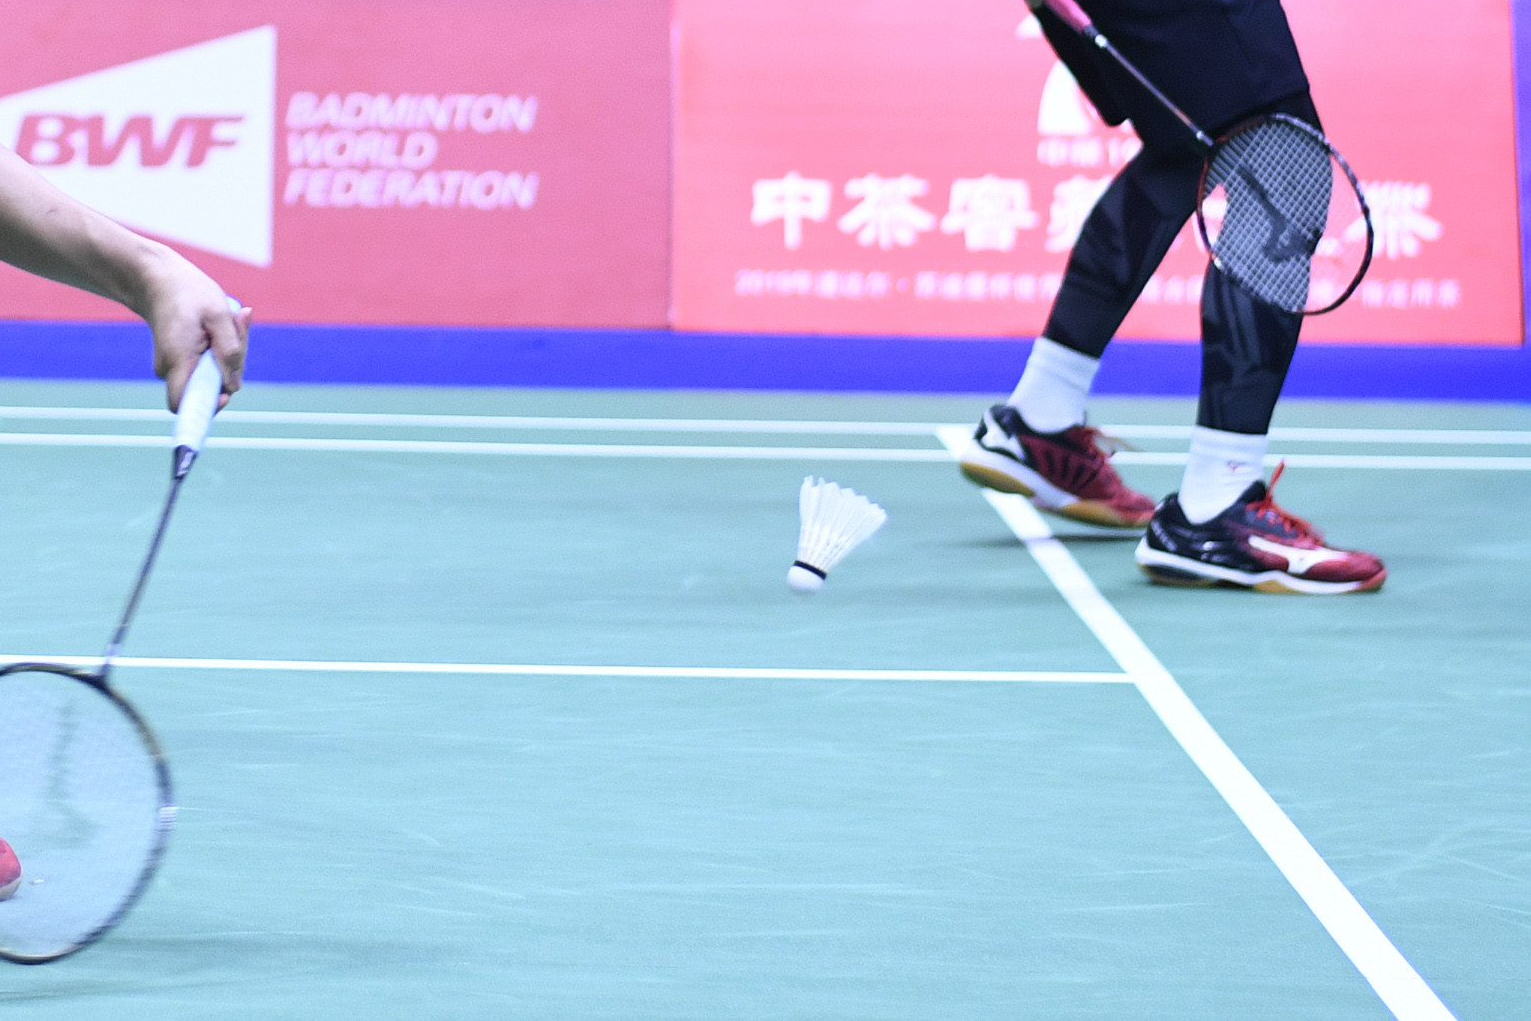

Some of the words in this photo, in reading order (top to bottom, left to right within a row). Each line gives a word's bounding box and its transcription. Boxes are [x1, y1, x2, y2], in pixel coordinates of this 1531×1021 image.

[285, 91, 538, 132] BADMINTON
[14, 113, 244, 169] BWF
[286, 131, 439, 171] WORLD
[283, 171, 539, 209] FEDERATION
